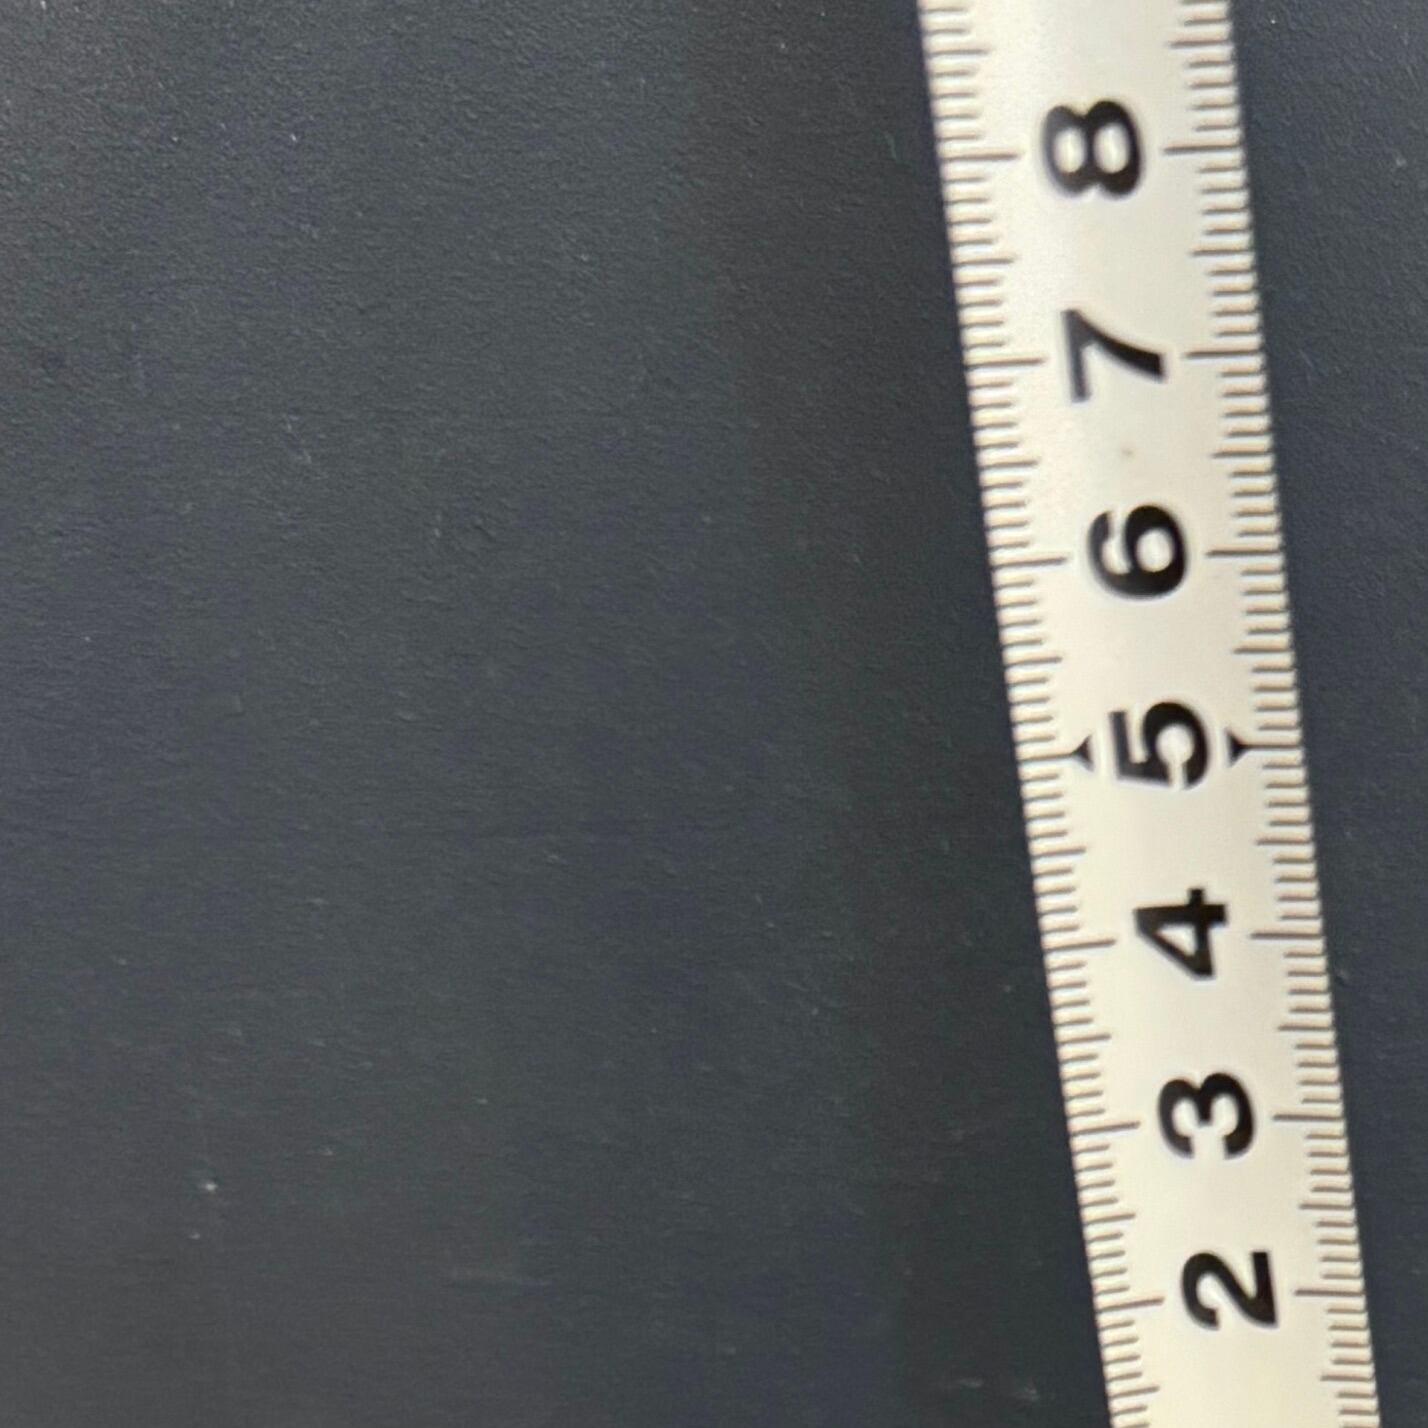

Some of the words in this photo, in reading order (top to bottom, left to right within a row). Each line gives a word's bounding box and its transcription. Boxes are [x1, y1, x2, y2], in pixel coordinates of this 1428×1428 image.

[1043, 100, 1143, 200] 8
[1061, 308, 1168, 403] 7
[1087, 504, 1190, 600] 6
[1108, 700, 1211, 791] 5
[1133, 886, 1229, 981] 4
[1157, 1072, 1258, 1160] 3
[1180, 1250, 1278, 1330] 2
